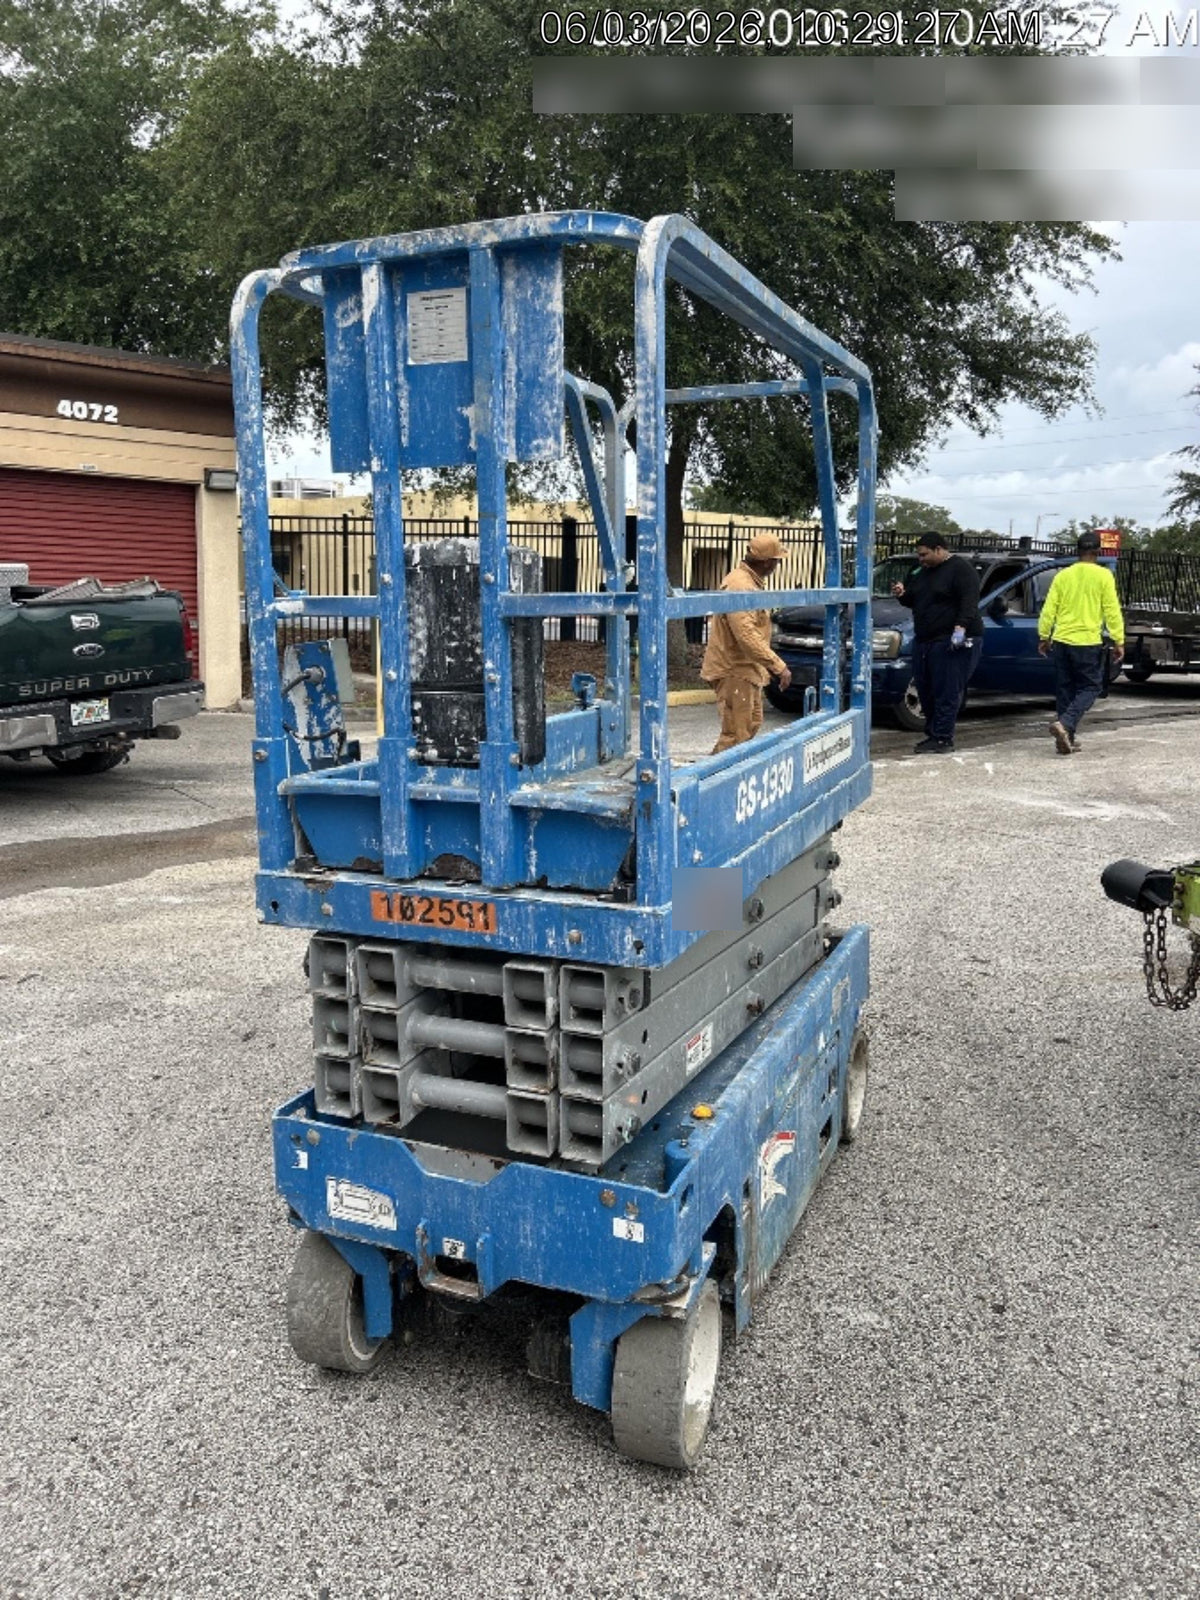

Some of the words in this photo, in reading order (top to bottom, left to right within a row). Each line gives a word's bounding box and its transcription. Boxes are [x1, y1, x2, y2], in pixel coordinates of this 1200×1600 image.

[57, 400, 119, 423] 4072
[18, 676, 90, 697] SUPER
[104, 669, 154, 686] DUTY
[735, 756, 794, 825] GS-1930
[380, 894, 491, 931] 102591
